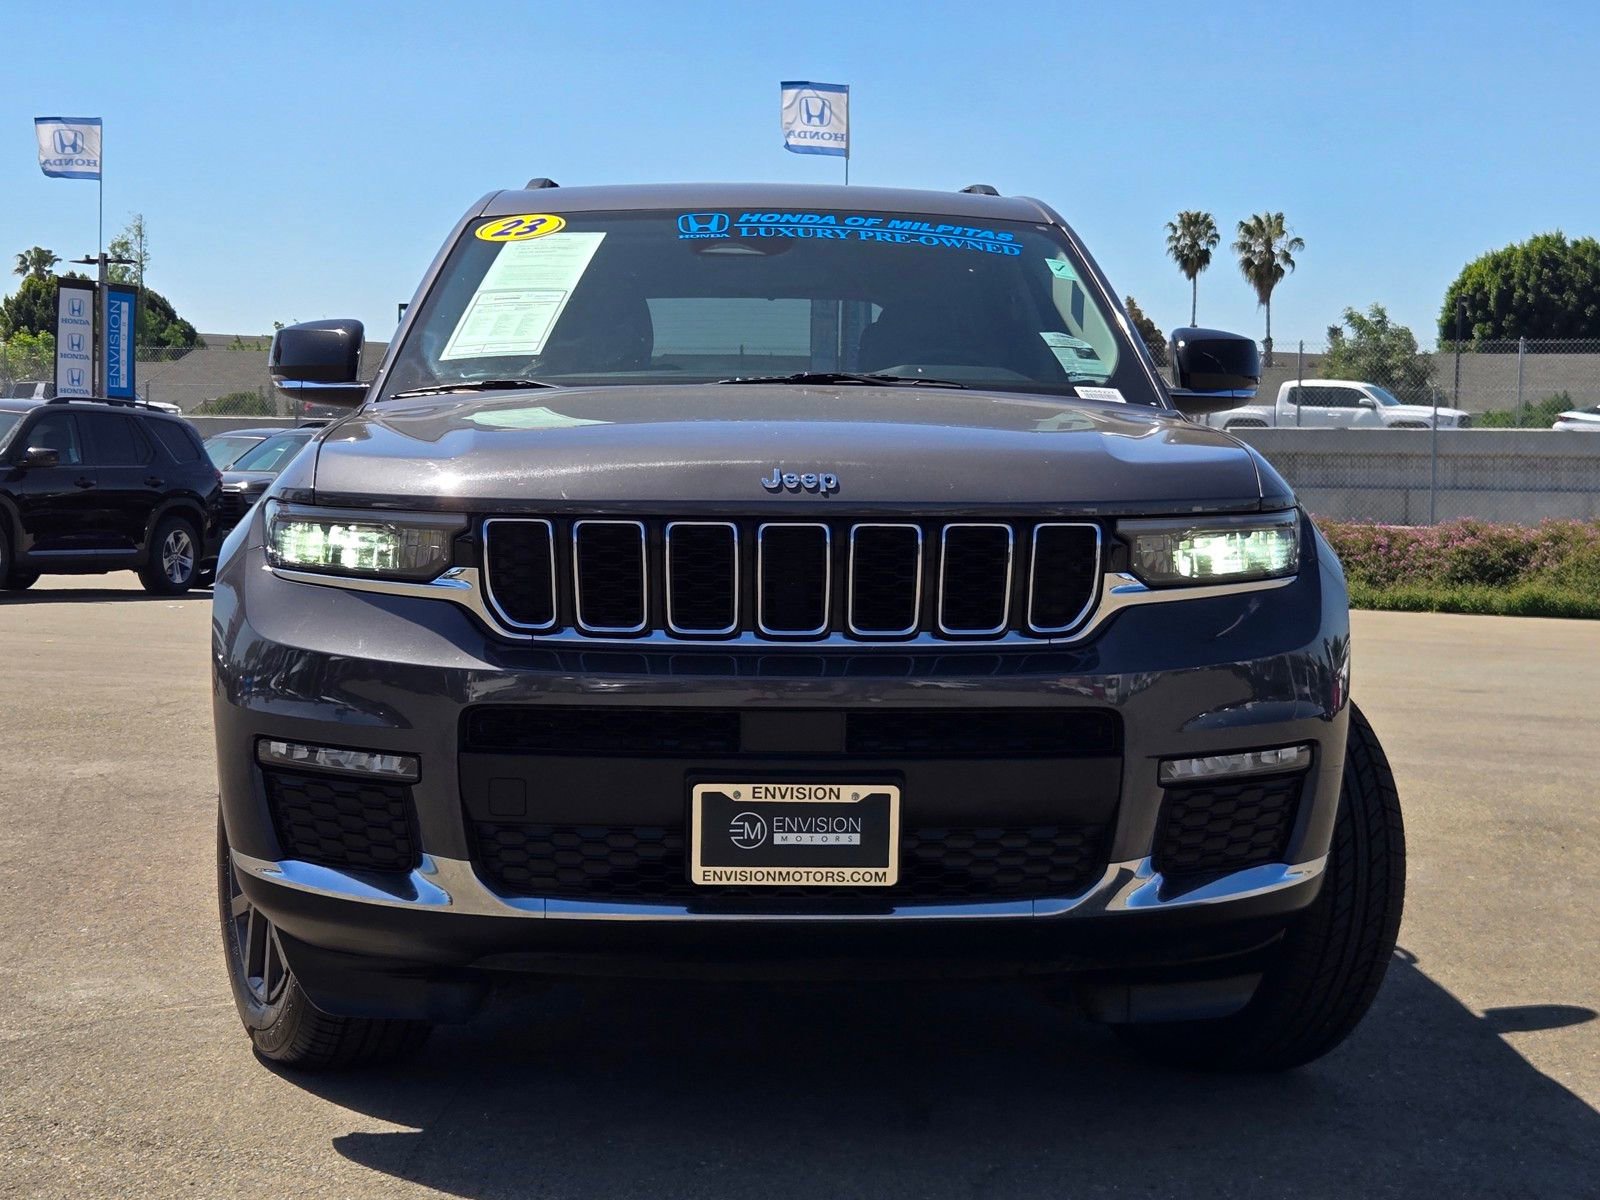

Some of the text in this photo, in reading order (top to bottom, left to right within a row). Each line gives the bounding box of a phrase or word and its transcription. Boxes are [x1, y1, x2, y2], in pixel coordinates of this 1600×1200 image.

[490, 218, 548, 237] 23
[738, 213, 1014, 241] HONDA OF MILPITAS
[741, 227, 1021, 256] LUXURY PRE-OWNED
[61, 318, 90, 326] HONDA
[109, 300, 120, 388] ENVISION
[60, 352, 90, 360] HONDA
[60, 387, 90, 395] HONDA
[761, 468, 837, 492] Jeep
[752, 786, 841, 800] ENVISION
[773, 817, 861, 832] ENVISION
[780, 835, 853, 843] MOTORS
[702, 870, 887, 883] ENVISIONMOTORS.COM
